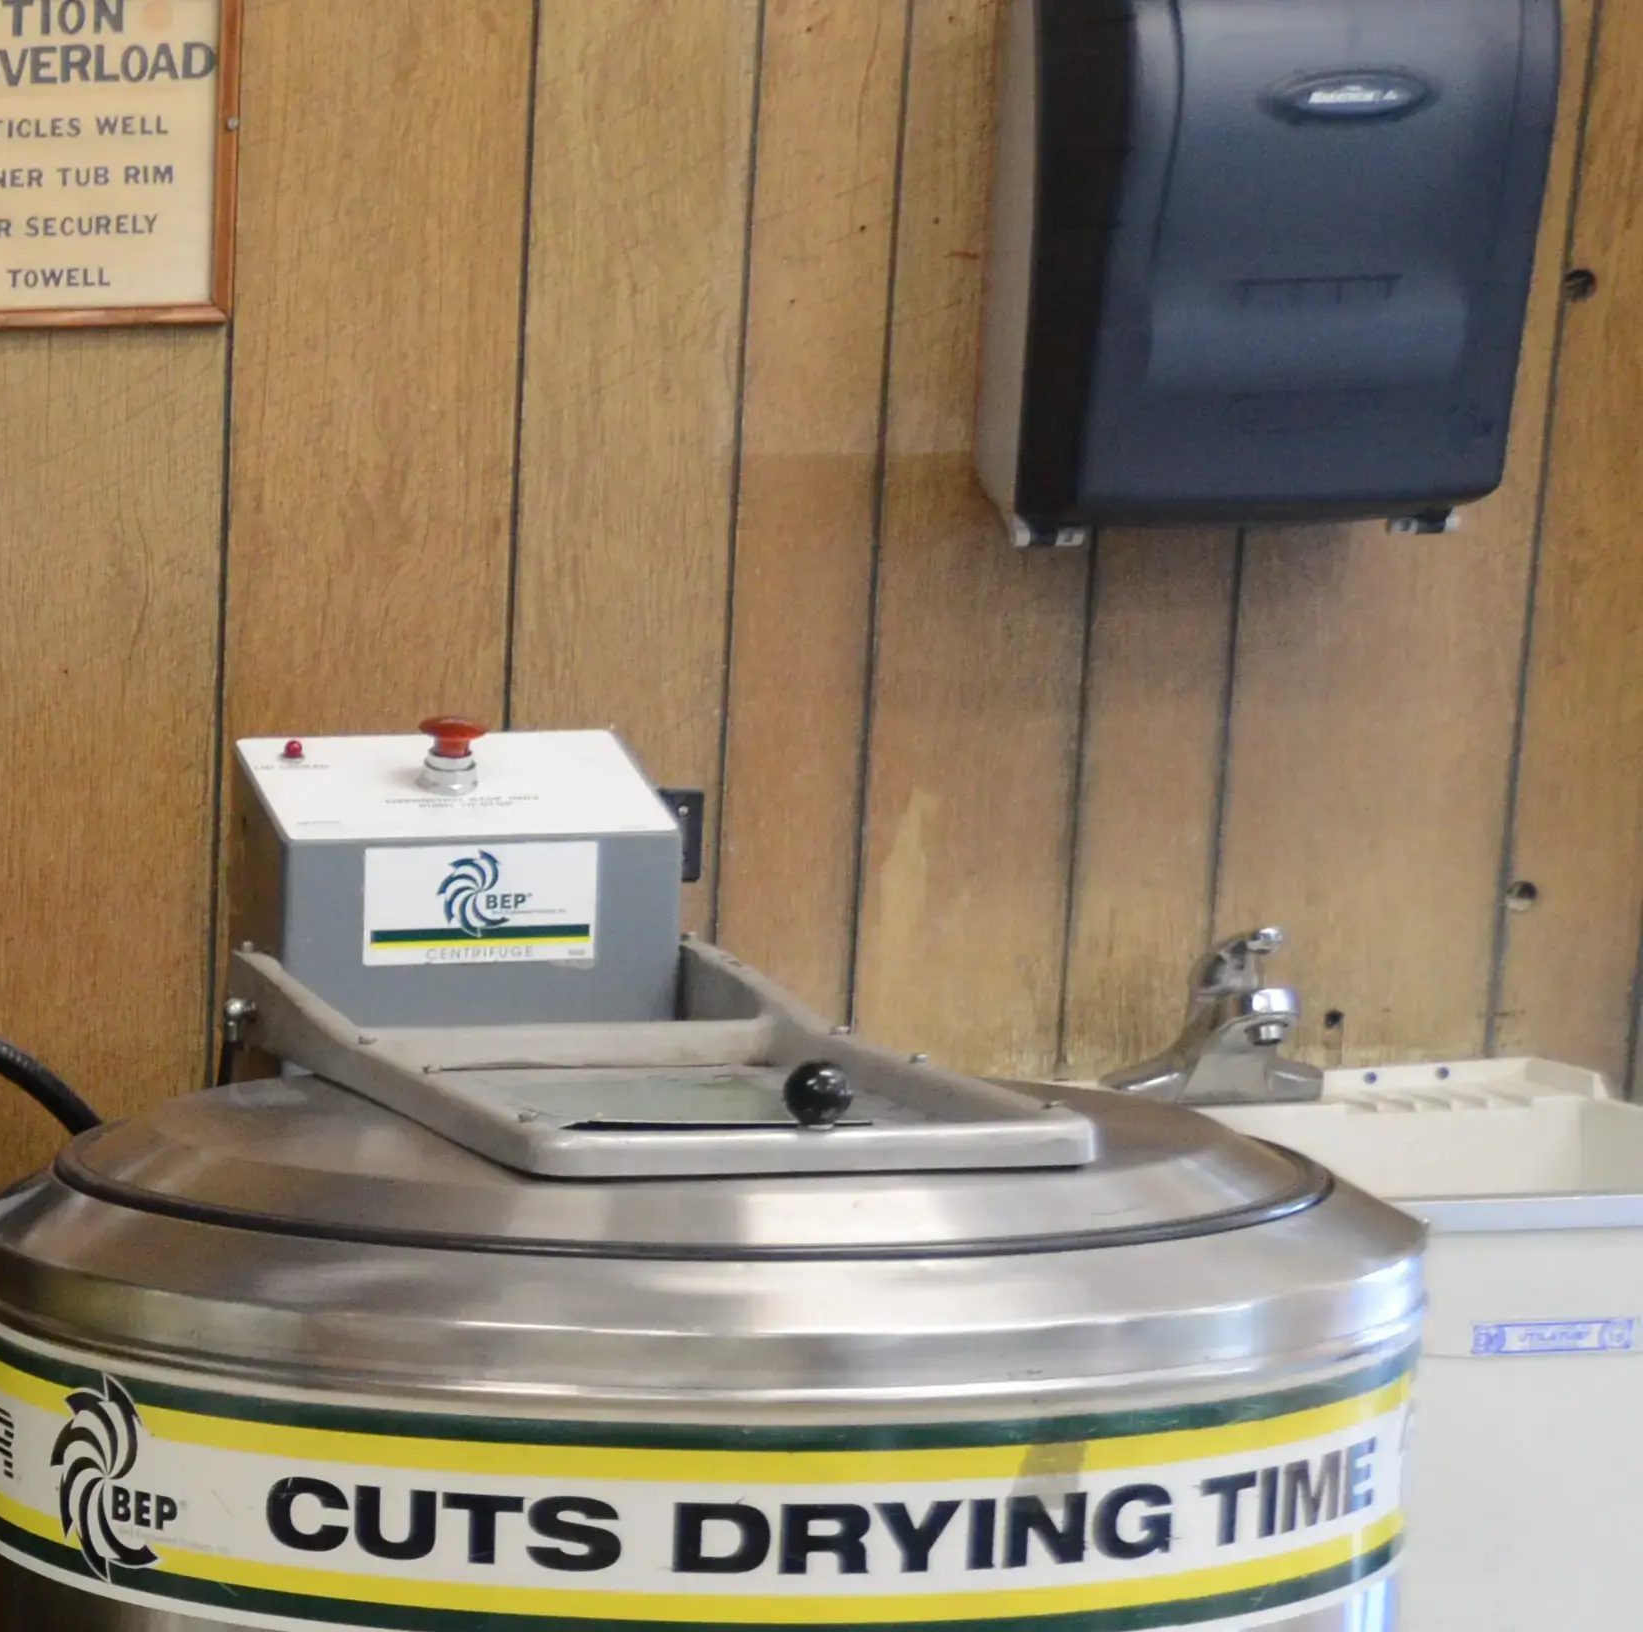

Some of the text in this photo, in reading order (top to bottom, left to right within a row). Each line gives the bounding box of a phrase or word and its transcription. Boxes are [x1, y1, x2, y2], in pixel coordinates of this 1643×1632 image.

[96, 115, 168, 136] WELL
[56, 167, 109, 191] TUB
[124, 165, 172, 184] RIM
[25, 214, 158, 238] SECURELY
[7, 267, 110, 288] TOWELL
[266, 1436, 1376, 1575] CUTS DRYING TIME
